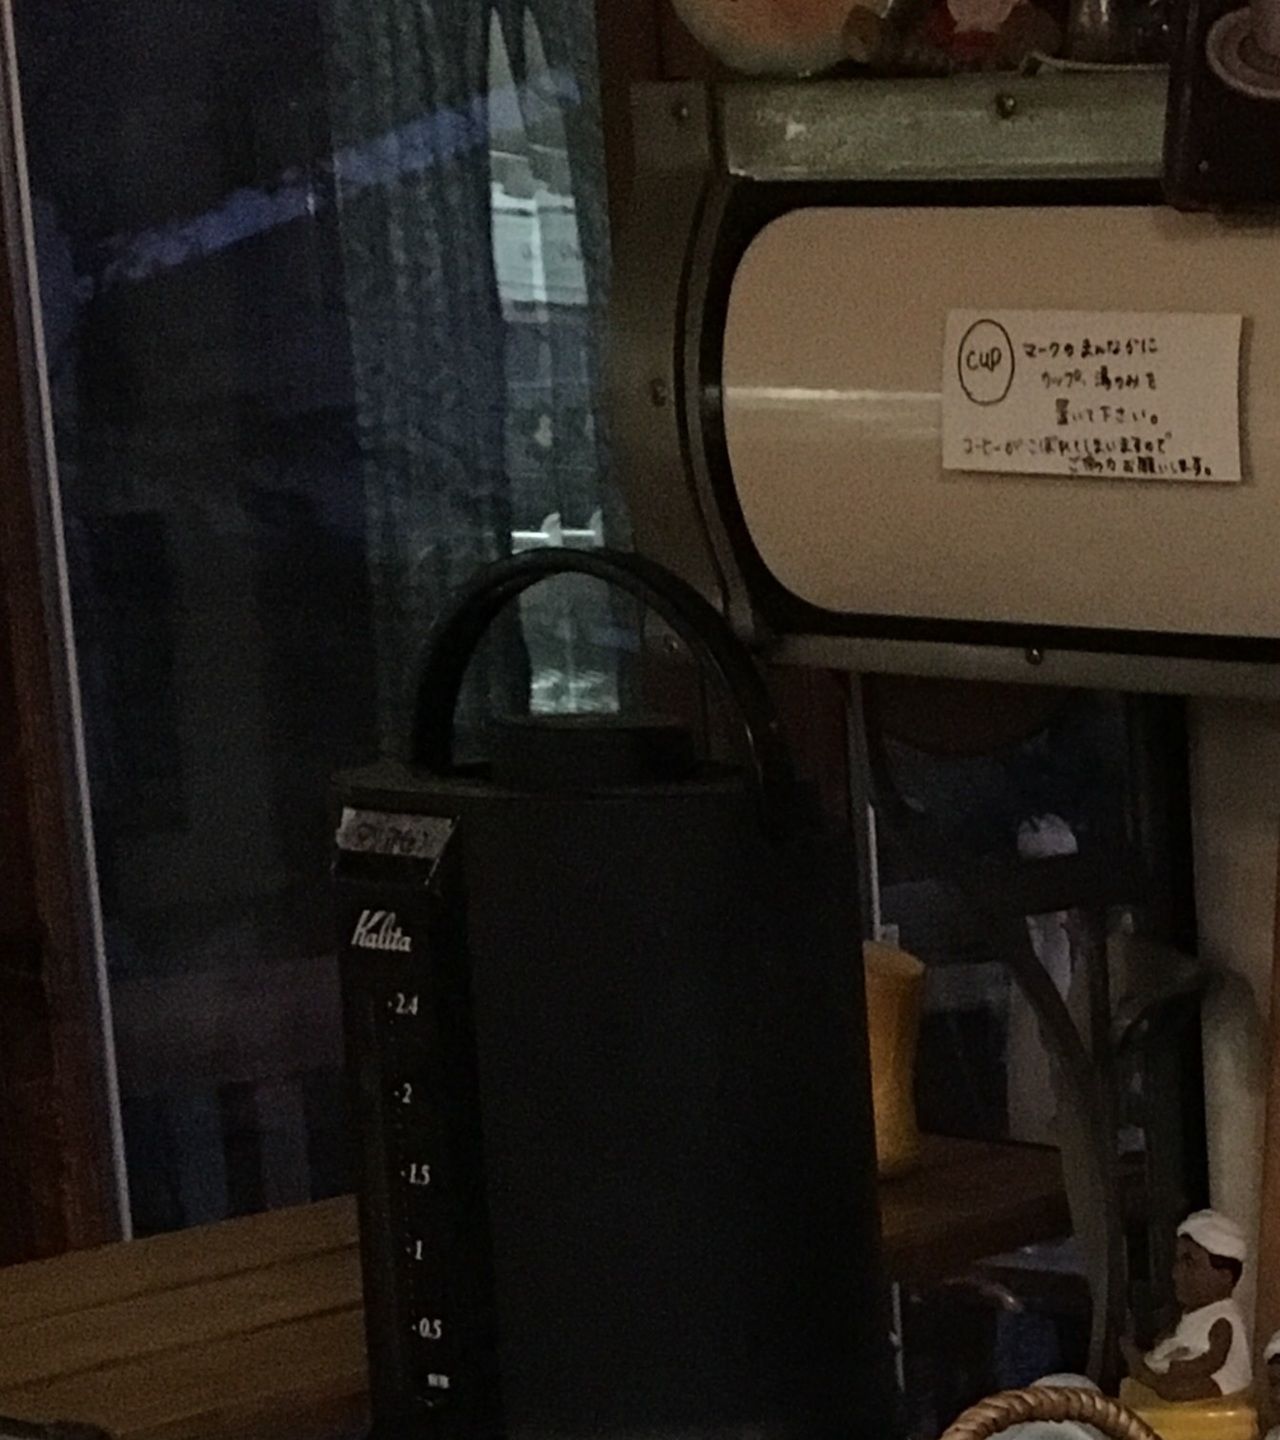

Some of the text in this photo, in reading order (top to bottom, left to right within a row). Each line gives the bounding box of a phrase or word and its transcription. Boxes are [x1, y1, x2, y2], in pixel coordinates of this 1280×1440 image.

[351, 909, 413, 953] Kalita
[402, 1082, 413, 1104] 2
[415, 1240, 423, 1261] 1
